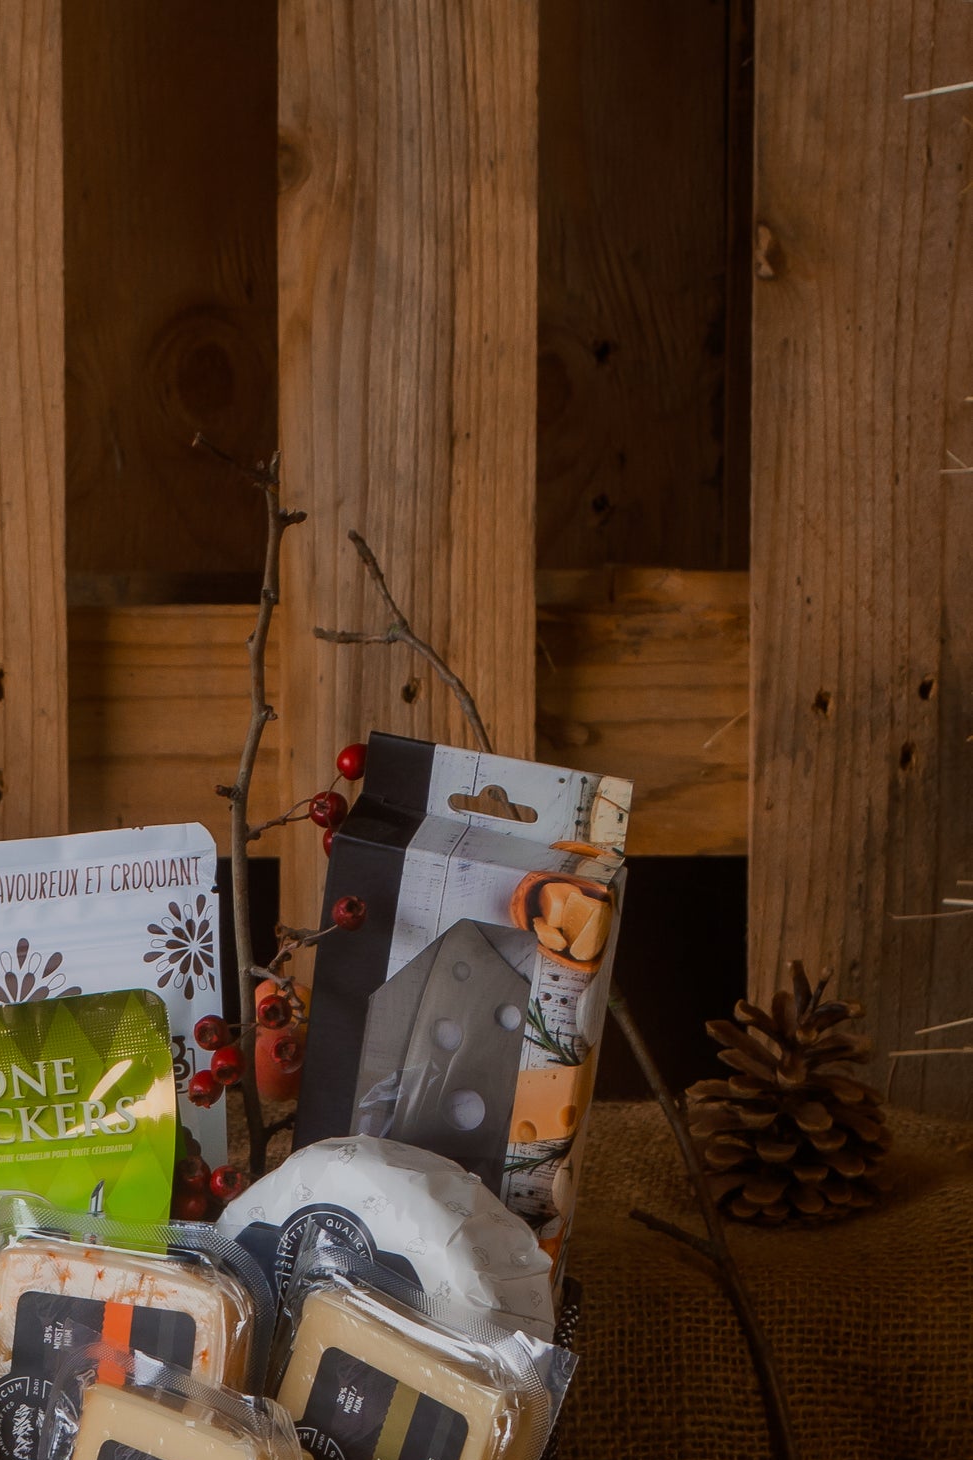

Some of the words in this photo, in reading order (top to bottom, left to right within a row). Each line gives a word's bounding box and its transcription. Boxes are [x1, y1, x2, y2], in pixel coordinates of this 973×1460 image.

[85, 866, 102, 894] ET
[110, 857, 201, 893] CROQUANT
[51, 1149, 69, 1159] POUR
[32, 1378, 40, 1395] 2001
